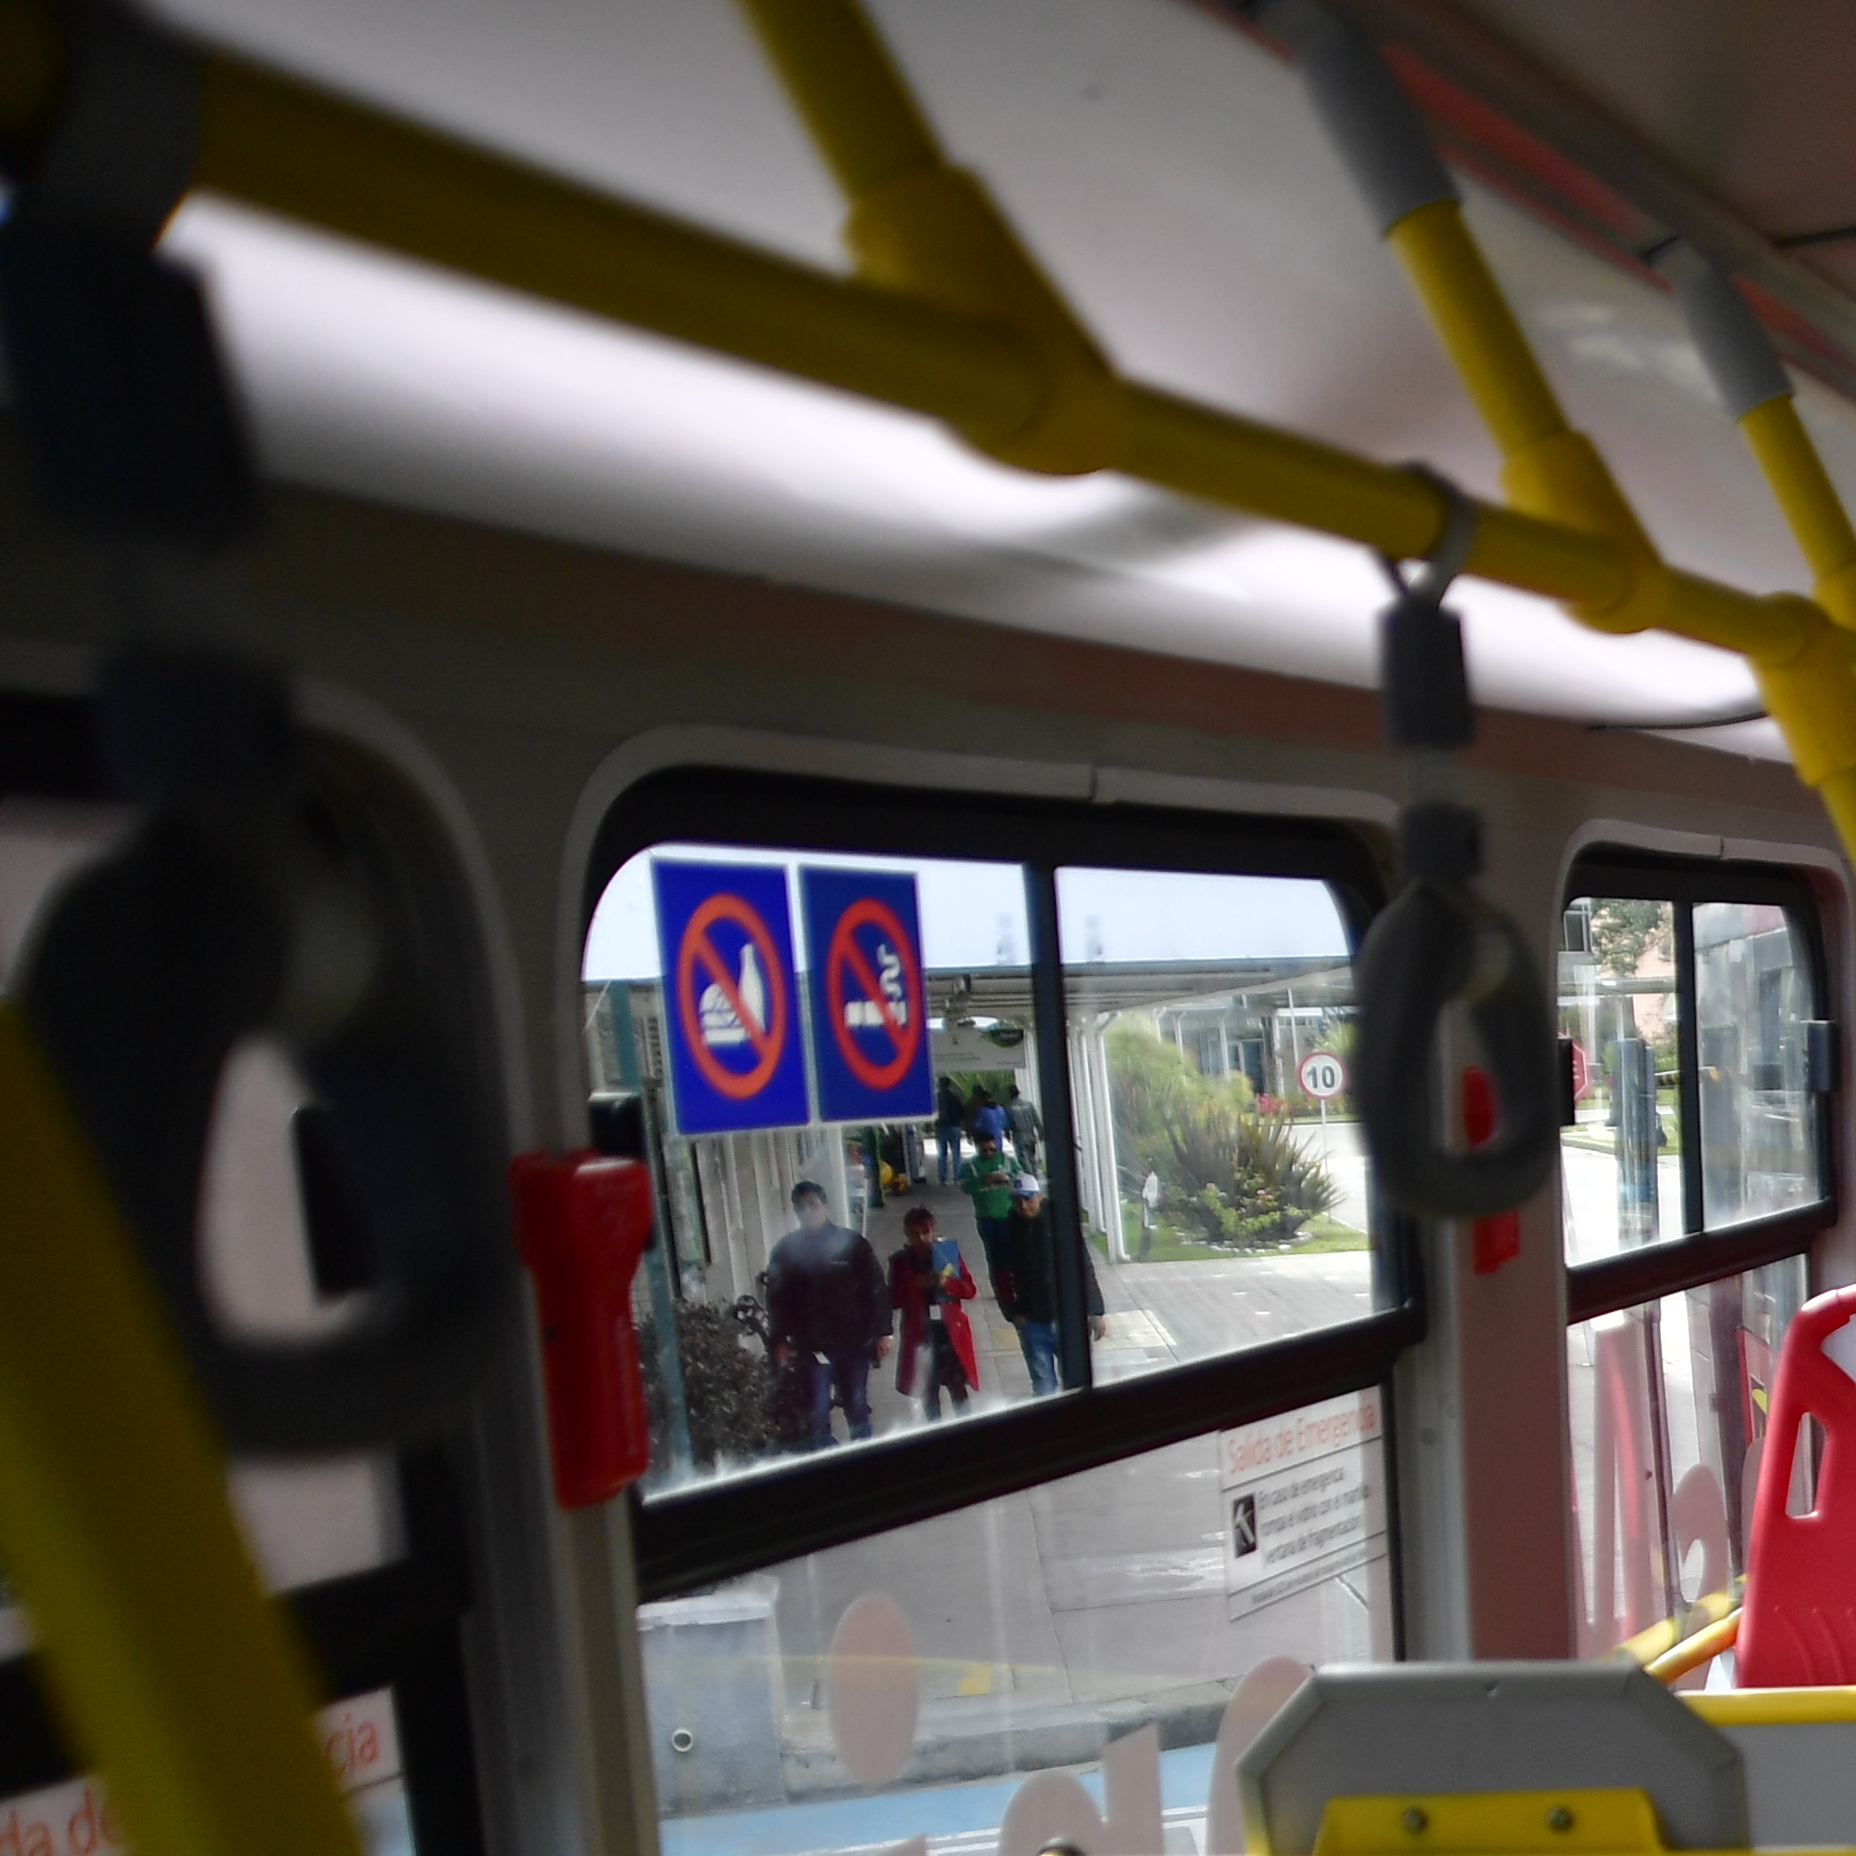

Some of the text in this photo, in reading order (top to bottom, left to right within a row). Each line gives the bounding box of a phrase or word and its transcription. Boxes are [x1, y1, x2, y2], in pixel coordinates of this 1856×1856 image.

[1307, 1066, 1336, 1089] 10
[1228, 1401, 1376, 1474] Salida de Emergencia
